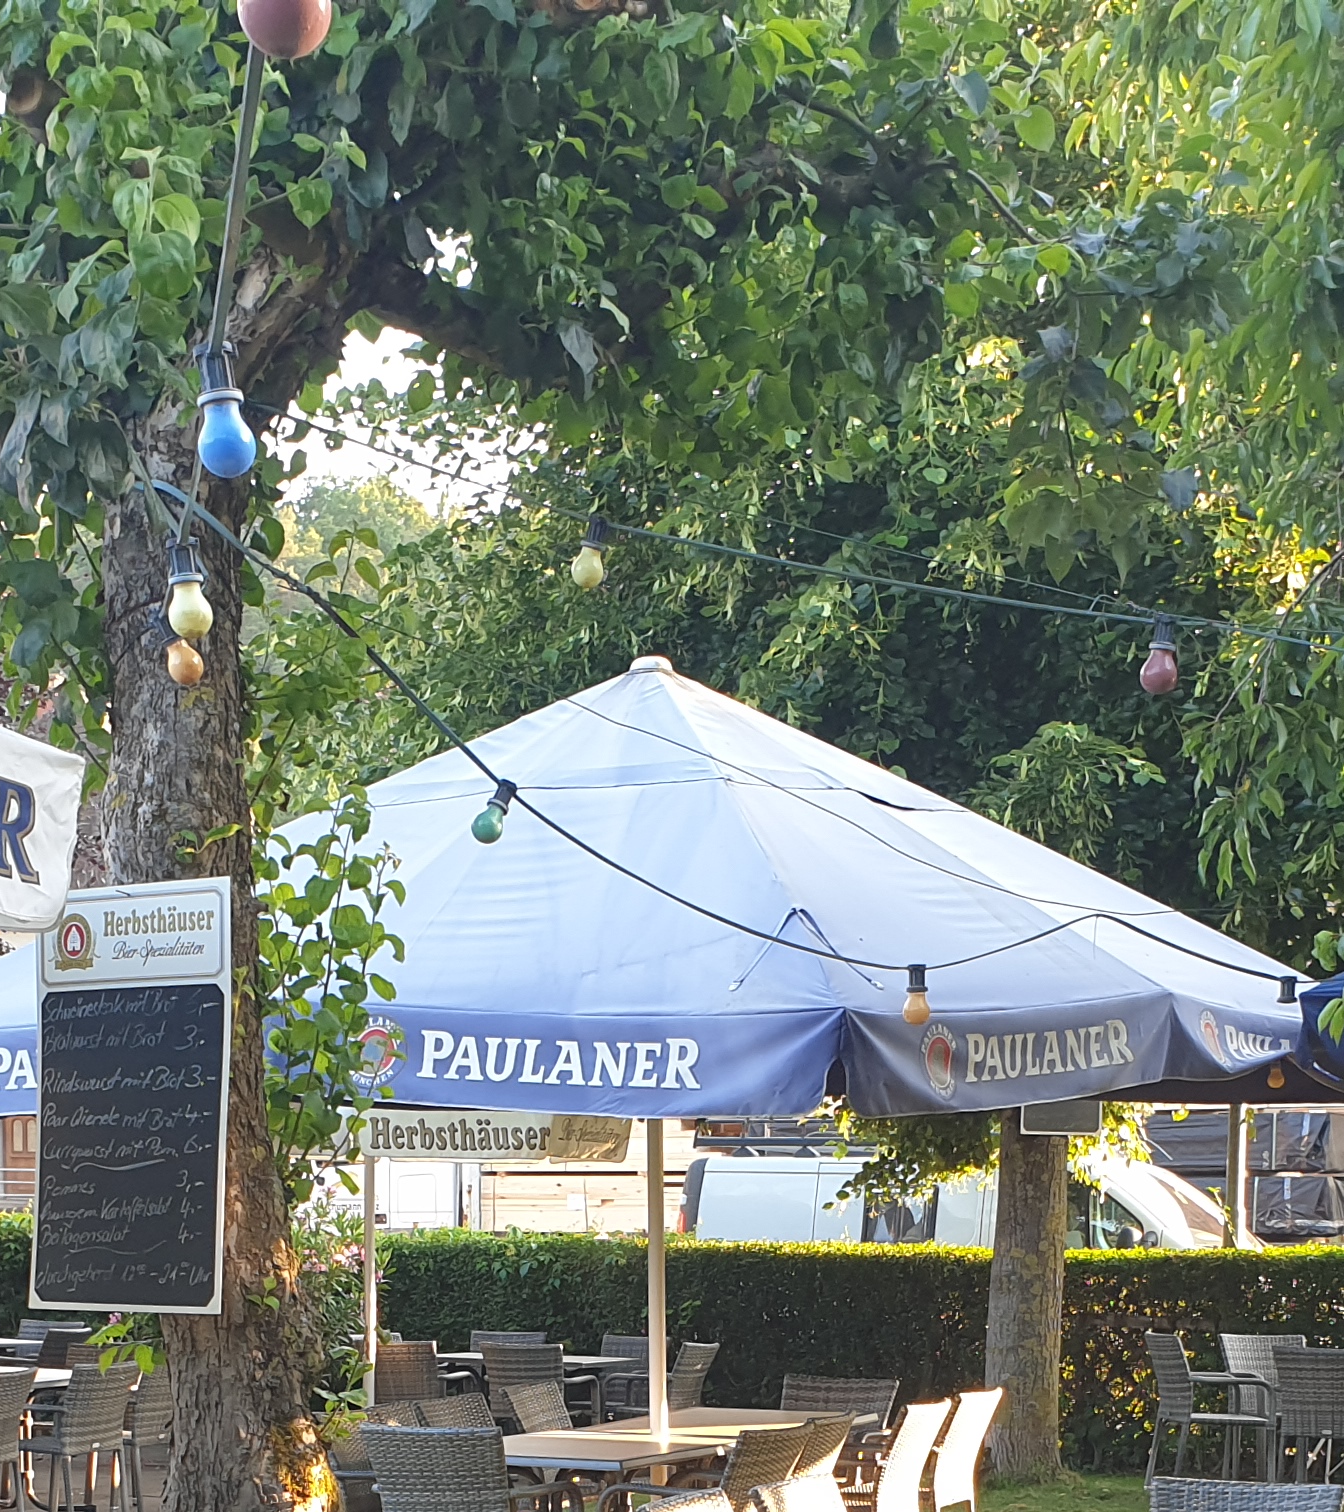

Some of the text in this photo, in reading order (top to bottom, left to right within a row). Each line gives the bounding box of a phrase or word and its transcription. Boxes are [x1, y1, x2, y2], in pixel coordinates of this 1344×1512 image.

[102, 906, 215, 937] Herbsthäuser
[111, 935, 206, 967] Bier-Spezialitäten
[129, 1020, 167, 1049] Brot
[416, 1029, 702, 1090] PAULANER
[965, 1019, 1135, 1083] PAULANER
[42, 1067, 122, 1094] Rindswurst
[121, 1068, 154, 1088] mit
[152, 1065, 186, 1091] Brot
[121, 1108, 149, 1129] mit
[369, 1116, 551, 1151] Herbsthäuser
[42, 1175, 96, 1200] Pommes
[40, 1223, 131, 1250] Beilagensalat
[188, 1265, 213, 1287] Uhr
